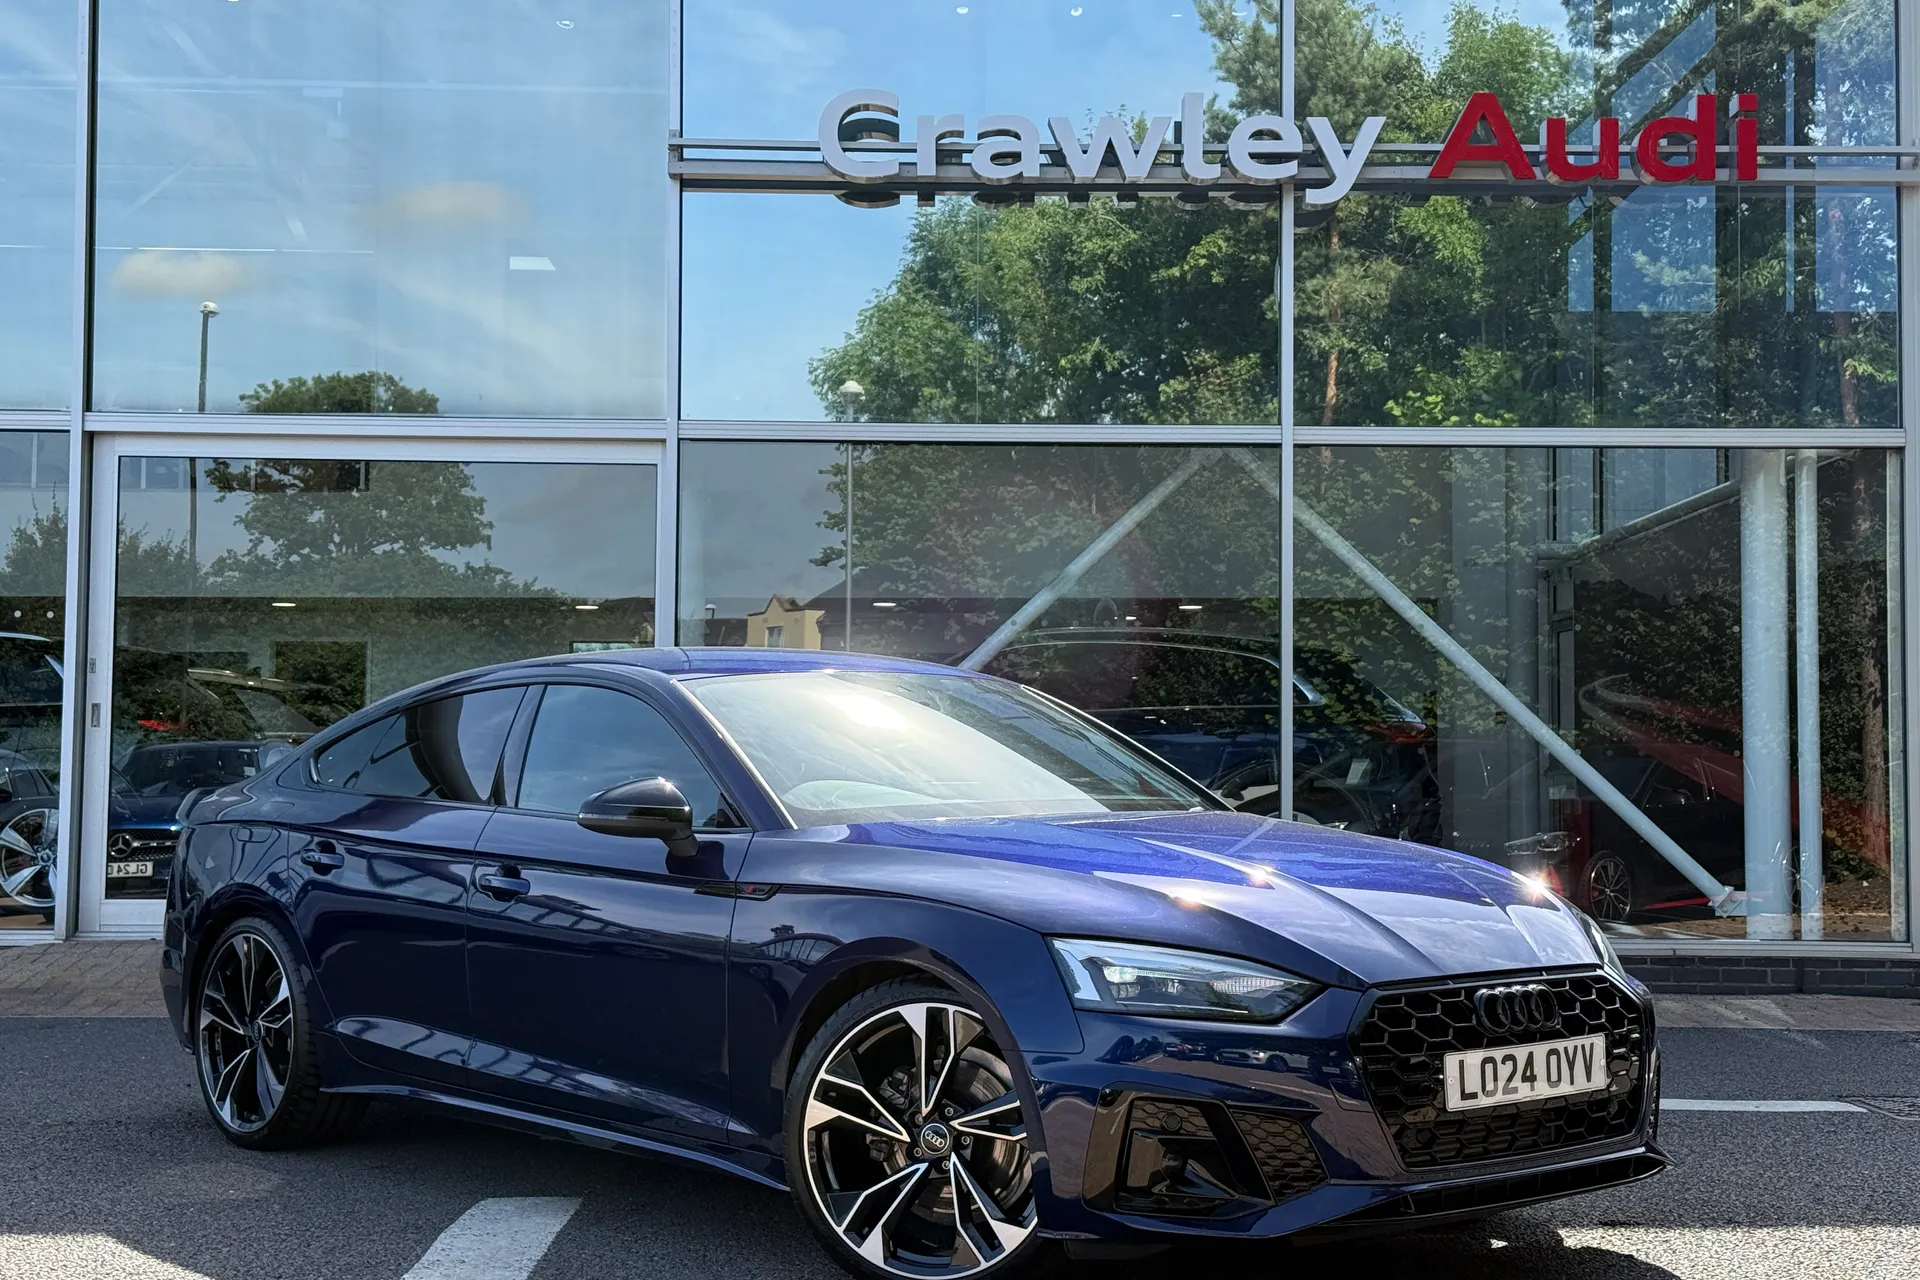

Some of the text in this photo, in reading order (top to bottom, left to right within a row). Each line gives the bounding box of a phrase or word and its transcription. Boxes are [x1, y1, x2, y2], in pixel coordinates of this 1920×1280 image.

[818, 88, 1758, 205] Crawley Audi
[1545, 1041, 1595, 1089] OYV
